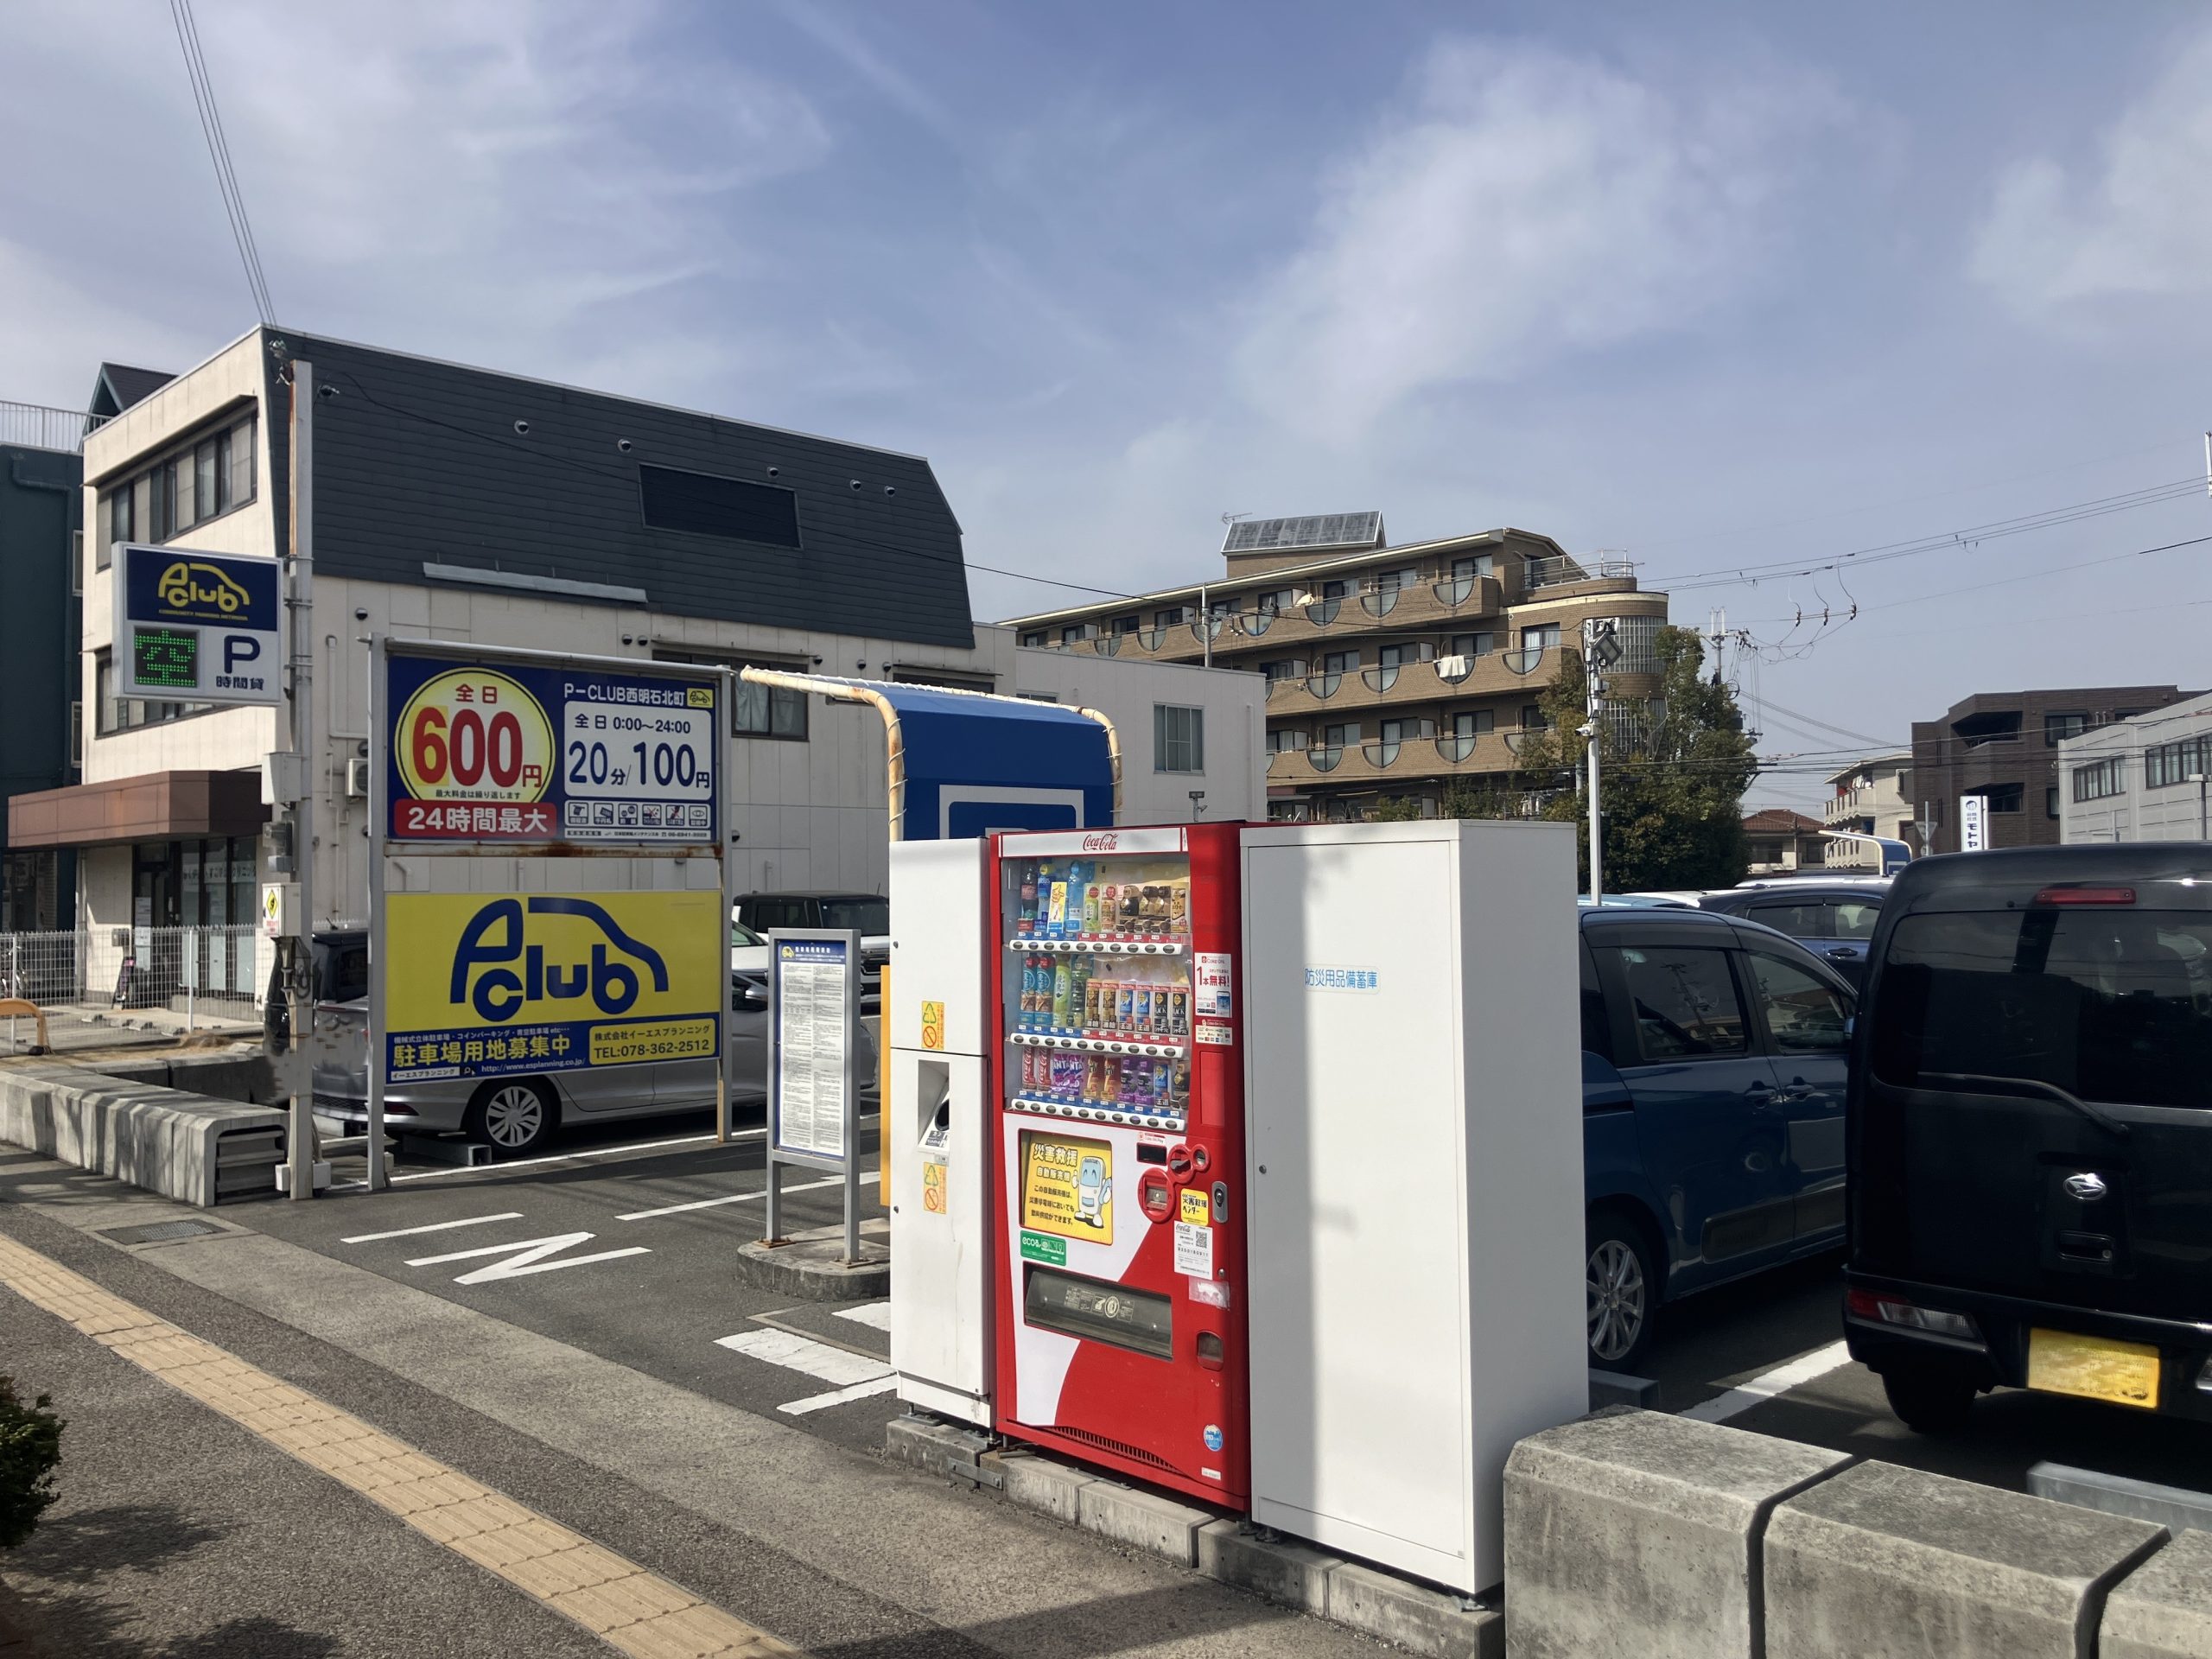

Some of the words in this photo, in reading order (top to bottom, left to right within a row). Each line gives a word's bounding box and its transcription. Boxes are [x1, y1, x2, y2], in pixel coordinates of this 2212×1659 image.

[135, 630, 198, 688] 空
[224, 634, 260, 674] P
[216, 676, 264, 690] 時間貸
[455, 683, 498, 704] 全日
[435, 790, 521, 800] 最大料金は繰り返します
[408, 806, 549, 833] 24時間最大
[1083, 833, 1119, 851] Coca-Cola
[1967, 823, 1978, 849] モトヤ
[1305, 968, 1377, 989] 防災用品備蓄庫
[594, 1025, 710, 1041] 株式会社イーエスプランニング
[393, 1034, 570, 1067] 駐車場用地募集中
[594, 1039, 709, 1058] TEL:078-362-2512
[393, 1069, 455, 1078] イーエスプランニング
[481, 1058, 586, 1073] http://www.esplanning.co.jp/
[1033, 1143, 1077, 1167] 災害救援
[1037, 1166, 1071, 1183] 自動販売機
[1182, 1197, 1207, 1209] 災害救援
